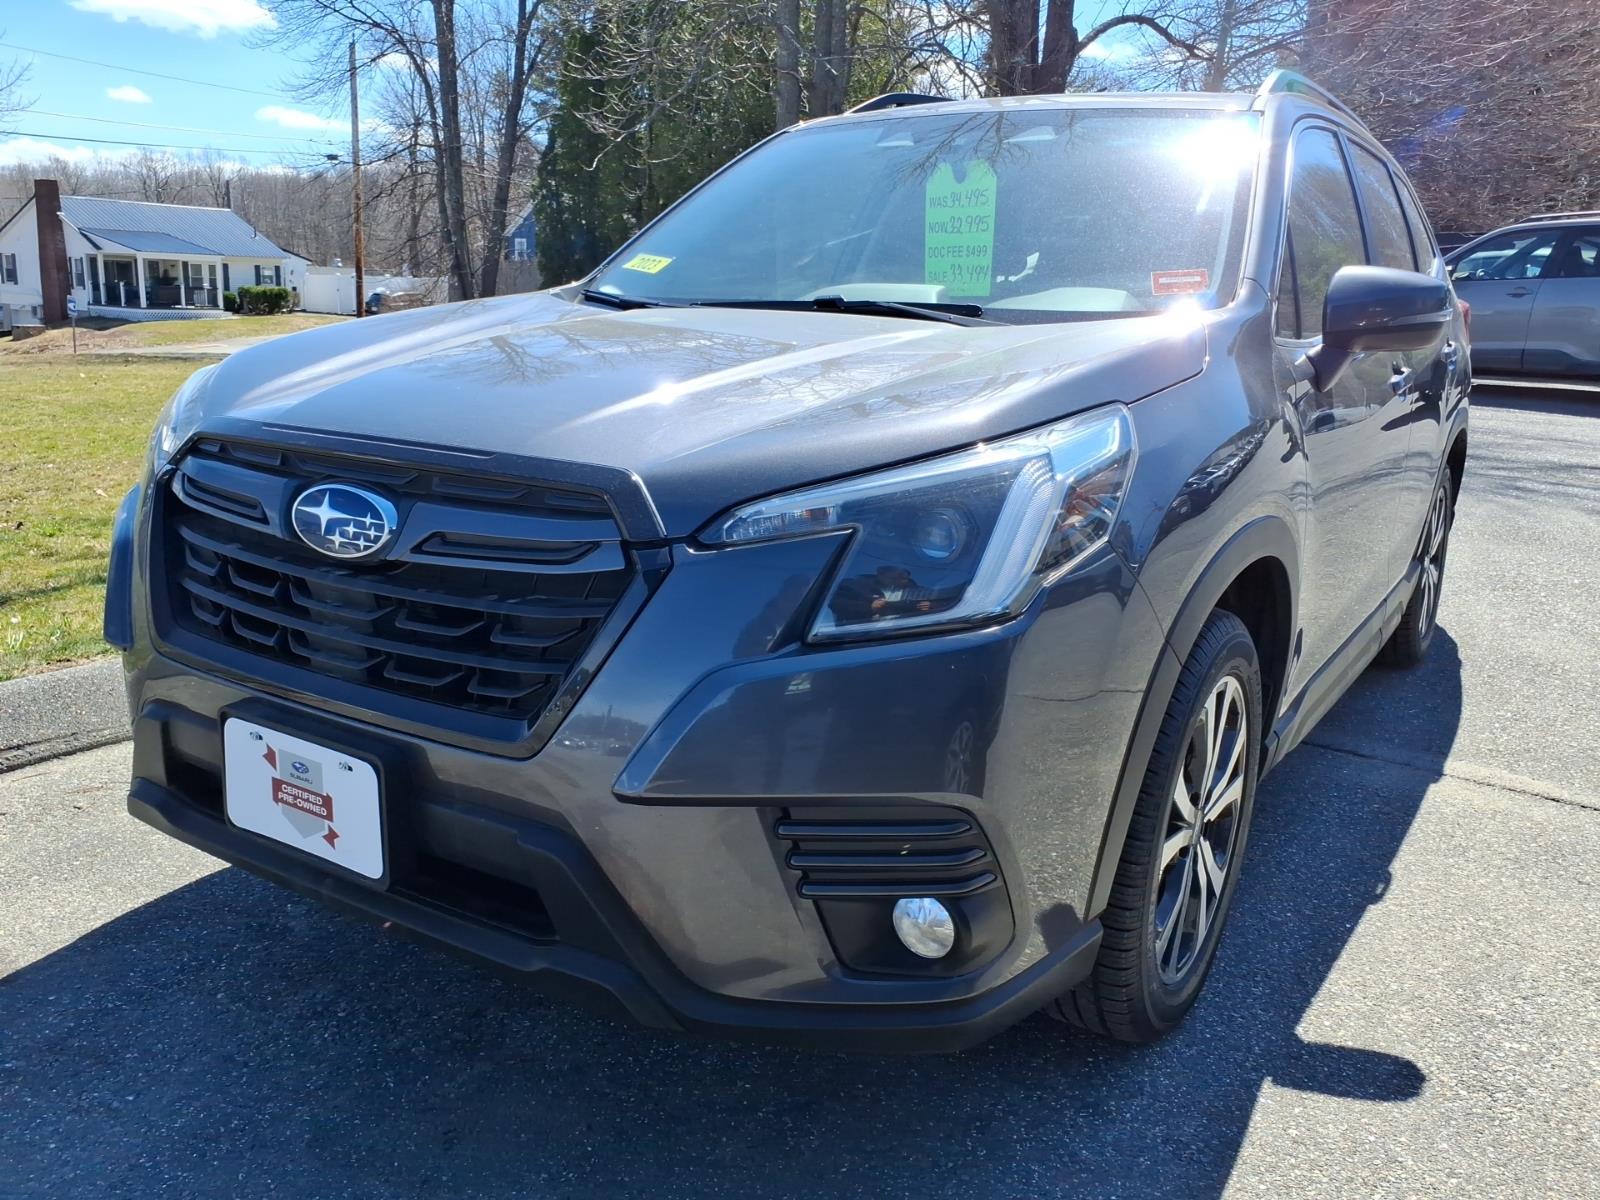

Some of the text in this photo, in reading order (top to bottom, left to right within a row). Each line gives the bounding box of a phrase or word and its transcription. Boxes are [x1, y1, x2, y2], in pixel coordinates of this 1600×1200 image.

[929, 196, 949, 208] WAS
[928, 221, 949, 233] NOW
[928, 244, 988, 258] DOC FEE $499
[290, 773, 313, 784] SUBARU
[281, 784, 323, 805] CERTIFIED
[278, 792, 327, 816] PRE-OWNED
